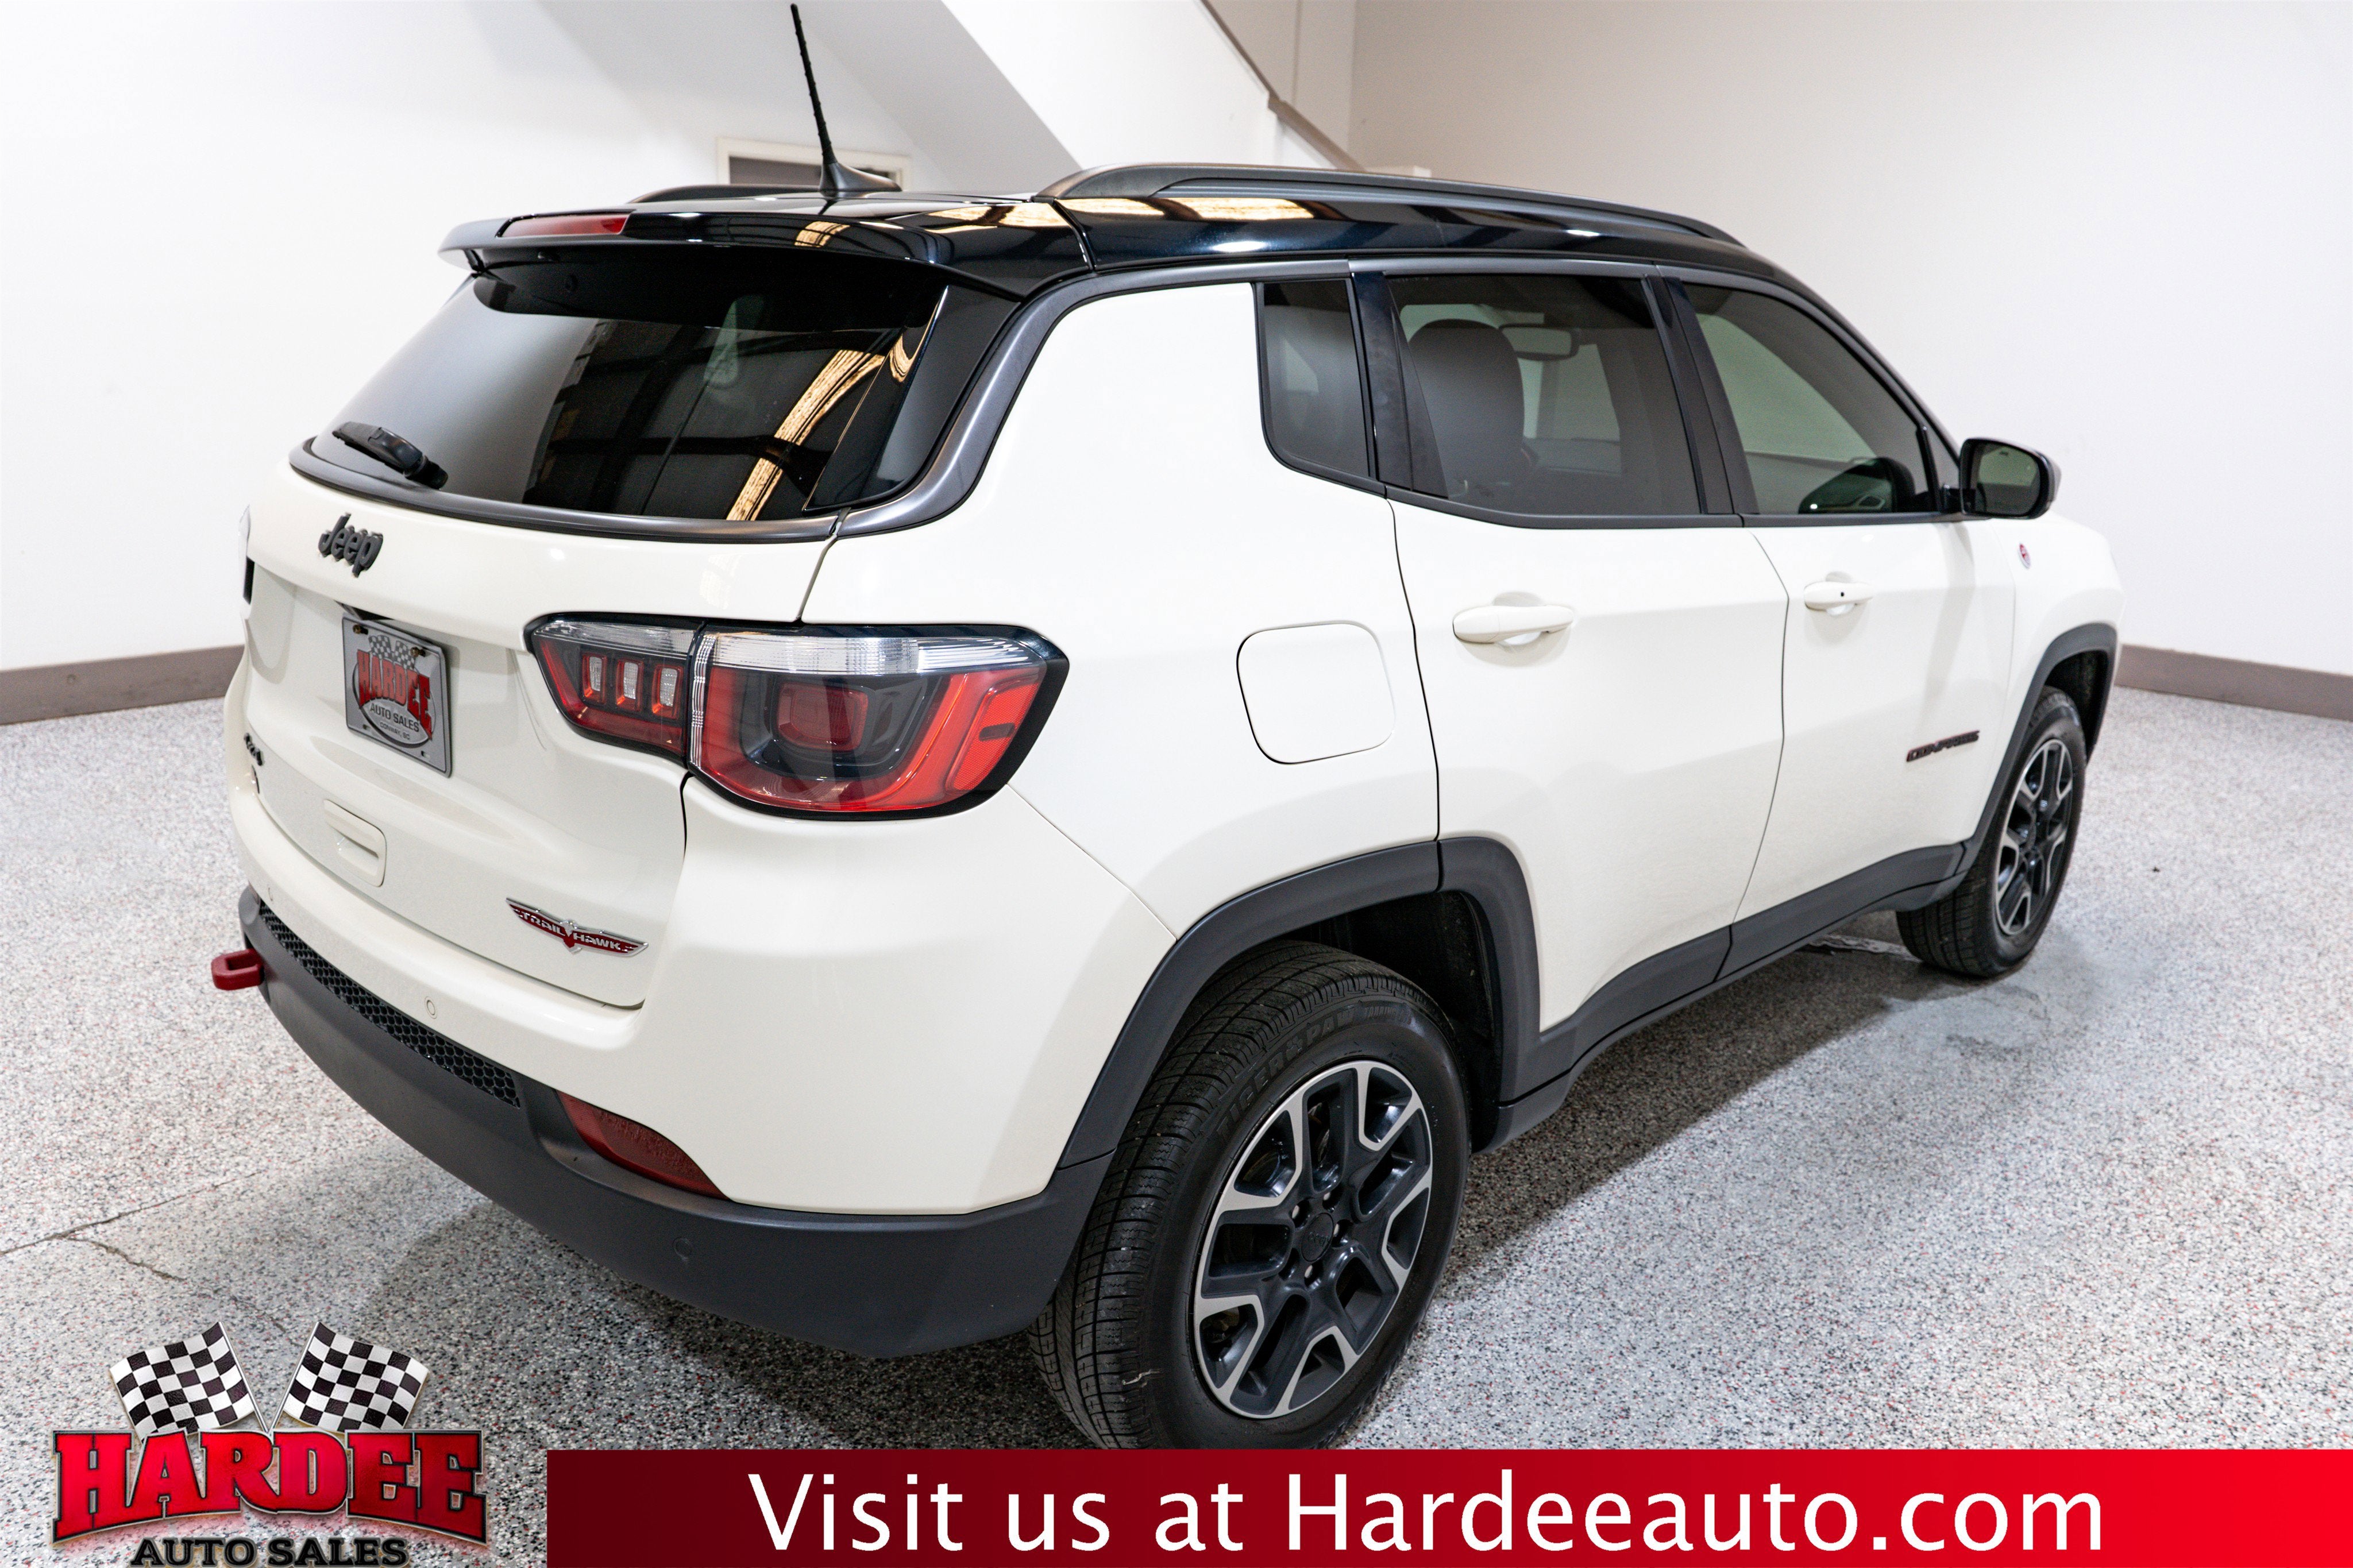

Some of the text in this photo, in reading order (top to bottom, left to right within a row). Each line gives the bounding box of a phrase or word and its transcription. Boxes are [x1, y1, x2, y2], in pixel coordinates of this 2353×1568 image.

[318, 512, 384, 578] Jeep
[357, 649, 433, 740] HARDEE
[369, 702, 419, 733] AUTO SALES
[1216, 1051, 1284, 1138] TIGER
[1306, 1005, 1356, 1046] PAW
